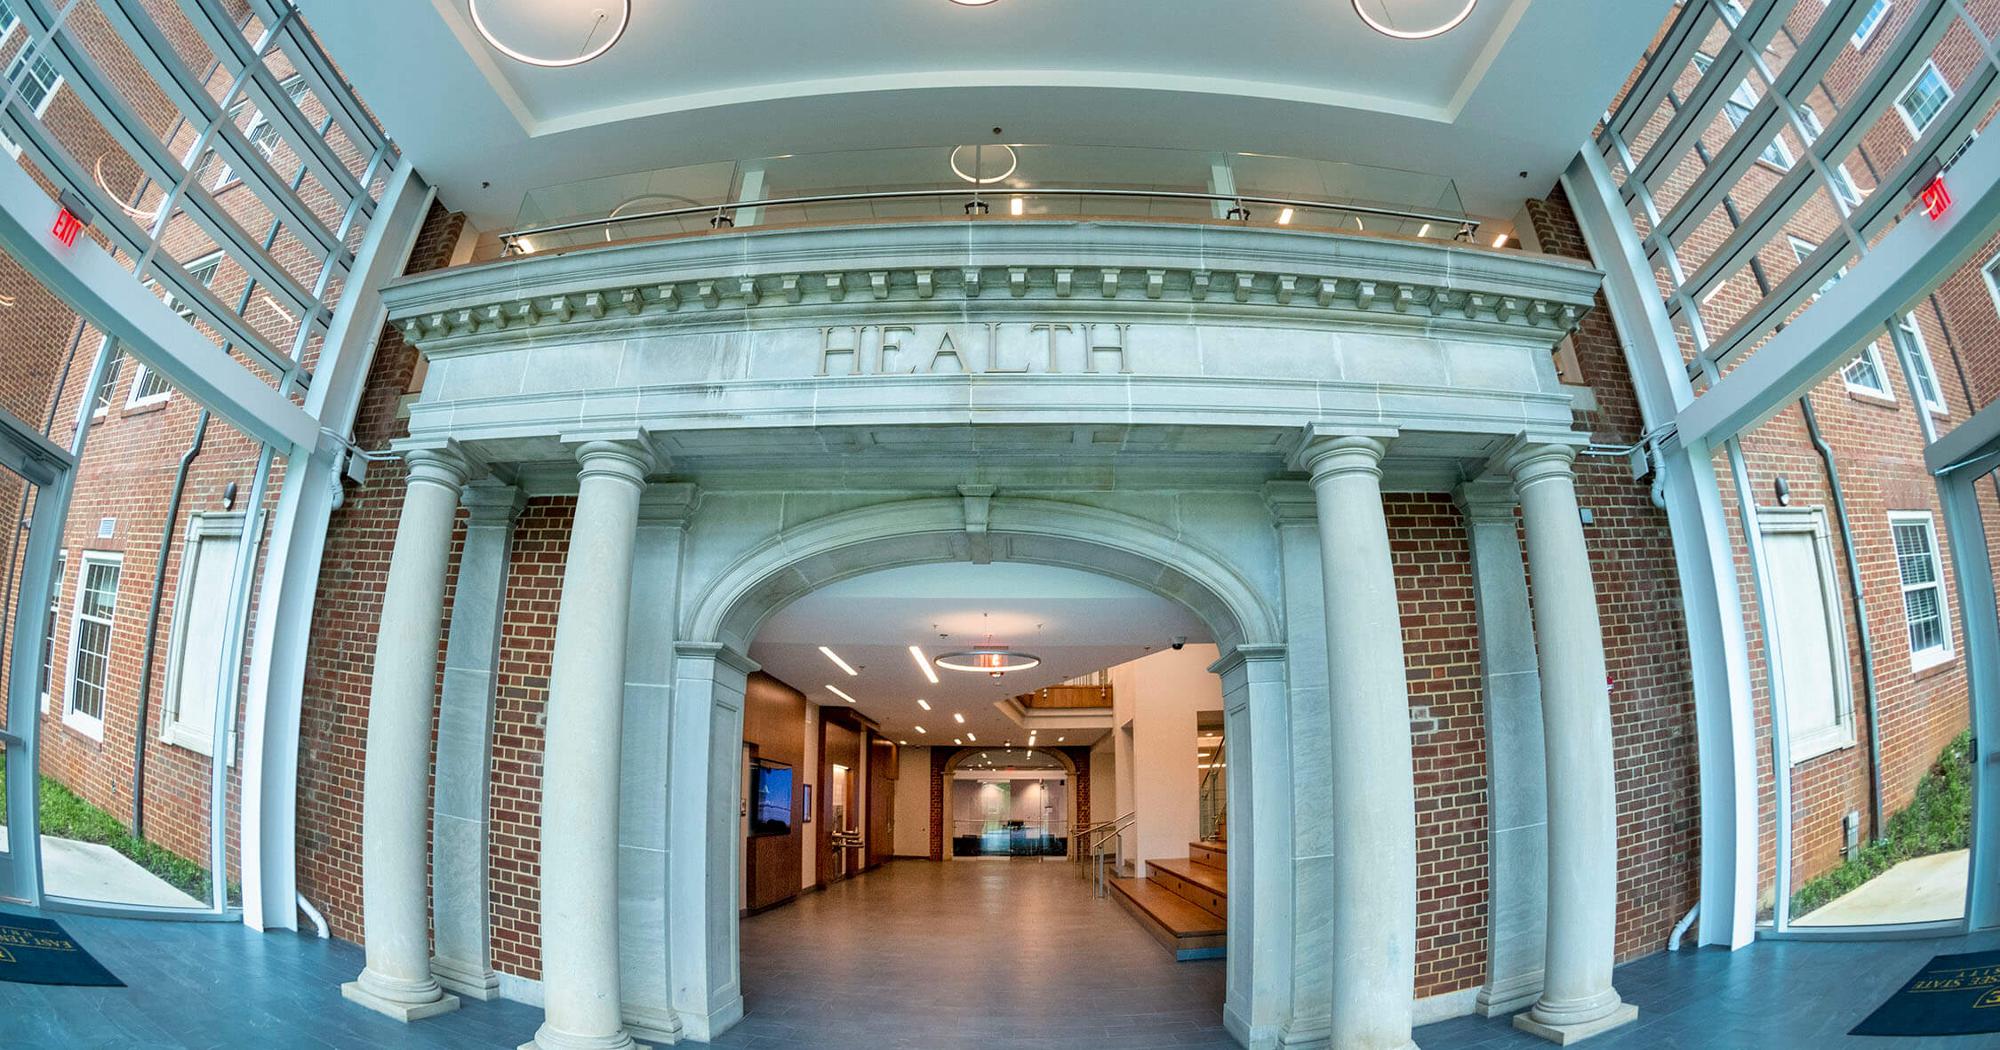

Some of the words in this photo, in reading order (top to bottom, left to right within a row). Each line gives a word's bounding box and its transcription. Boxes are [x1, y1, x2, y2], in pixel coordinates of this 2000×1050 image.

[1922, 178, 1951, 220] EXIT
[52, 208, 81, 247] EXIT
[813, 321, 1135, 376] HEALTH
